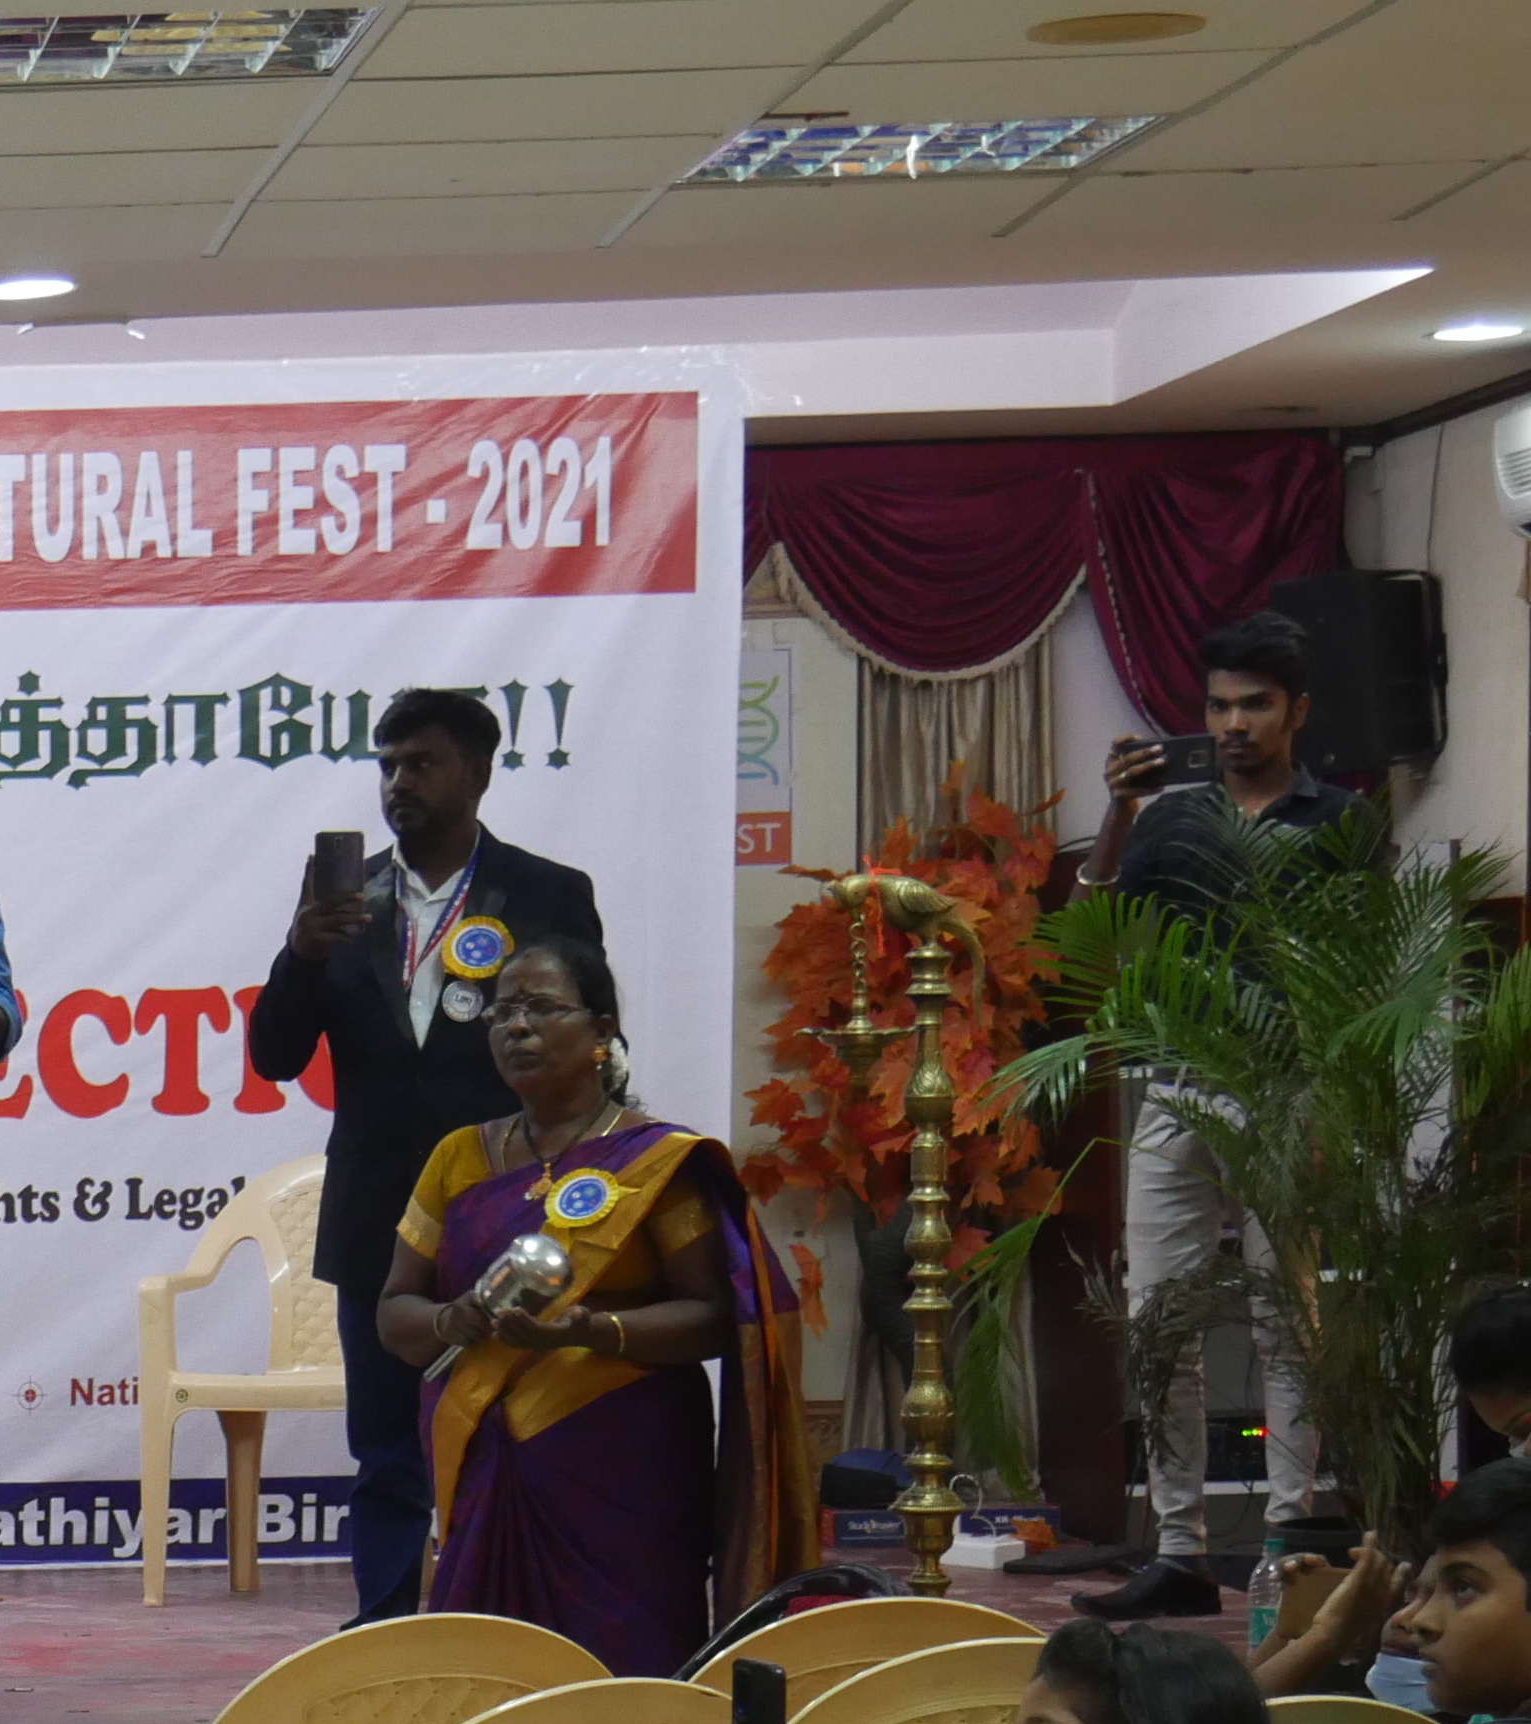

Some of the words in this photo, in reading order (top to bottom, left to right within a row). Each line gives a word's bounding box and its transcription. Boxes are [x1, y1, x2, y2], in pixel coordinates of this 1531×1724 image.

[236, 443, 406, 557] FEST
[466, 436, 614, 551] 2021
[73, 1176, 114, 1223] &
